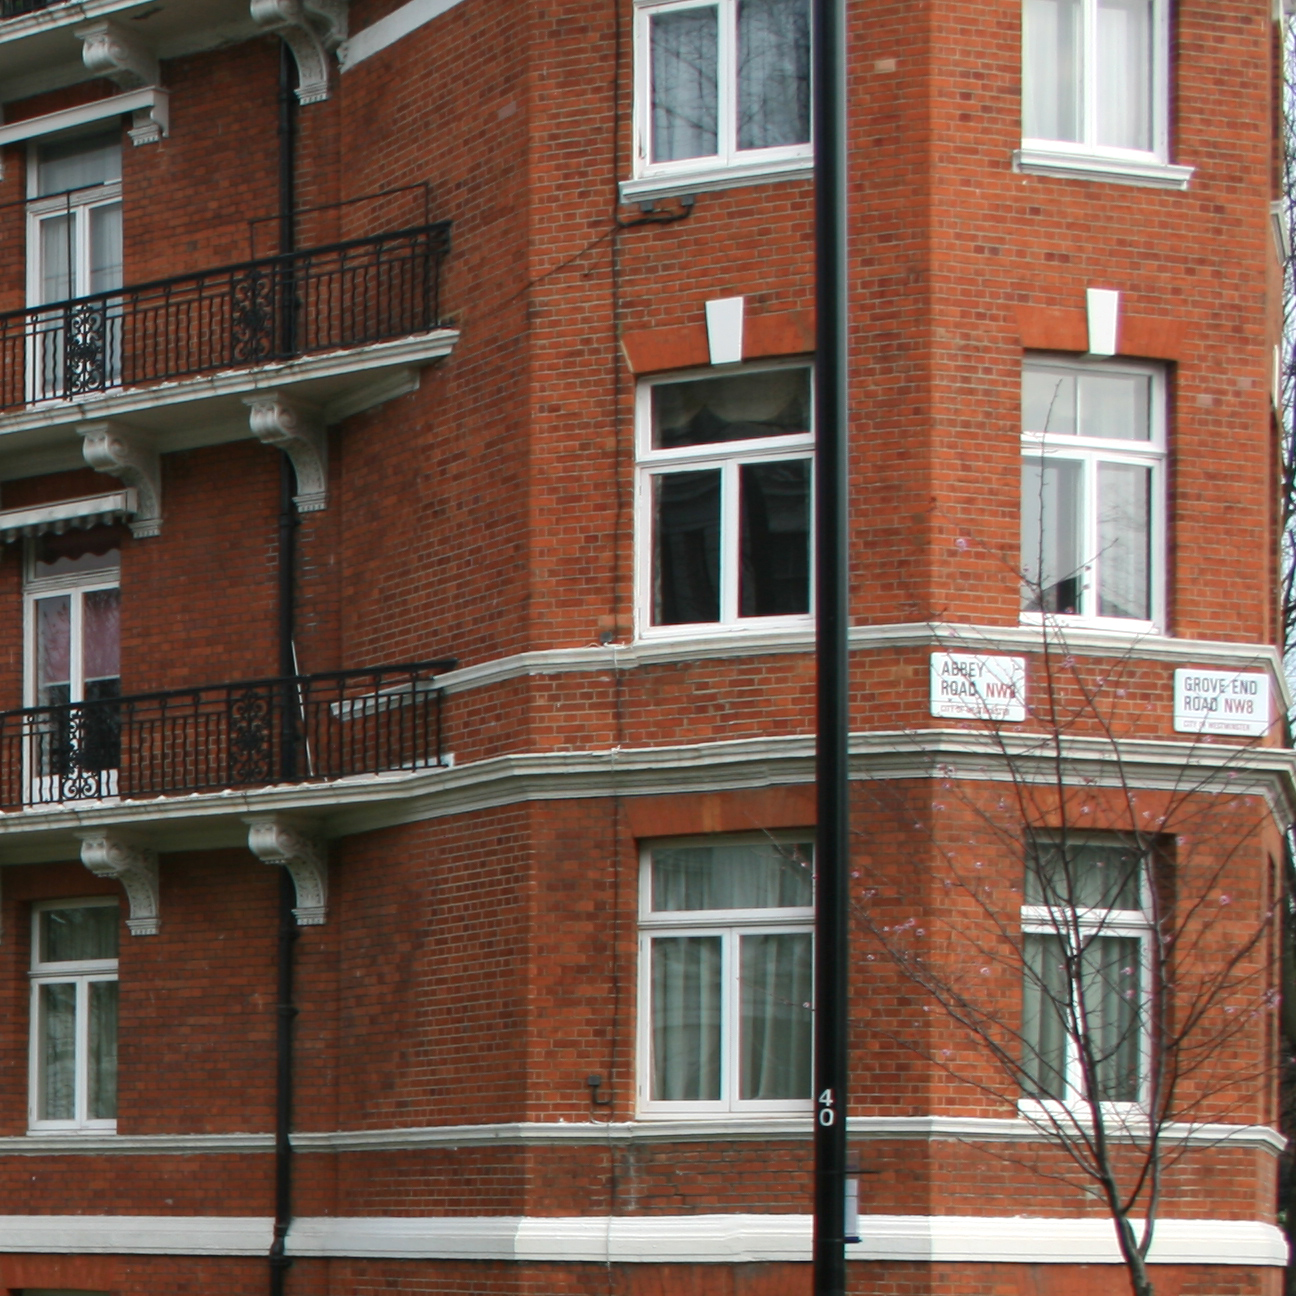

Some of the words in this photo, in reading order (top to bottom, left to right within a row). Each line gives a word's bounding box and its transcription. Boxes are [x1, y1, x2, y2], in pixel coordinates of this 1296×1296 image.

[942, 661, 984, 677] ABBEY
[941, 681, 977, 696] ROAD
[1184, 677, 1226, 693] GROVE
[1232, 679, 1257, 695] END
[1184, 696, 1219, 712] ROAD
[1224, 698, 1254, 714] NW8
